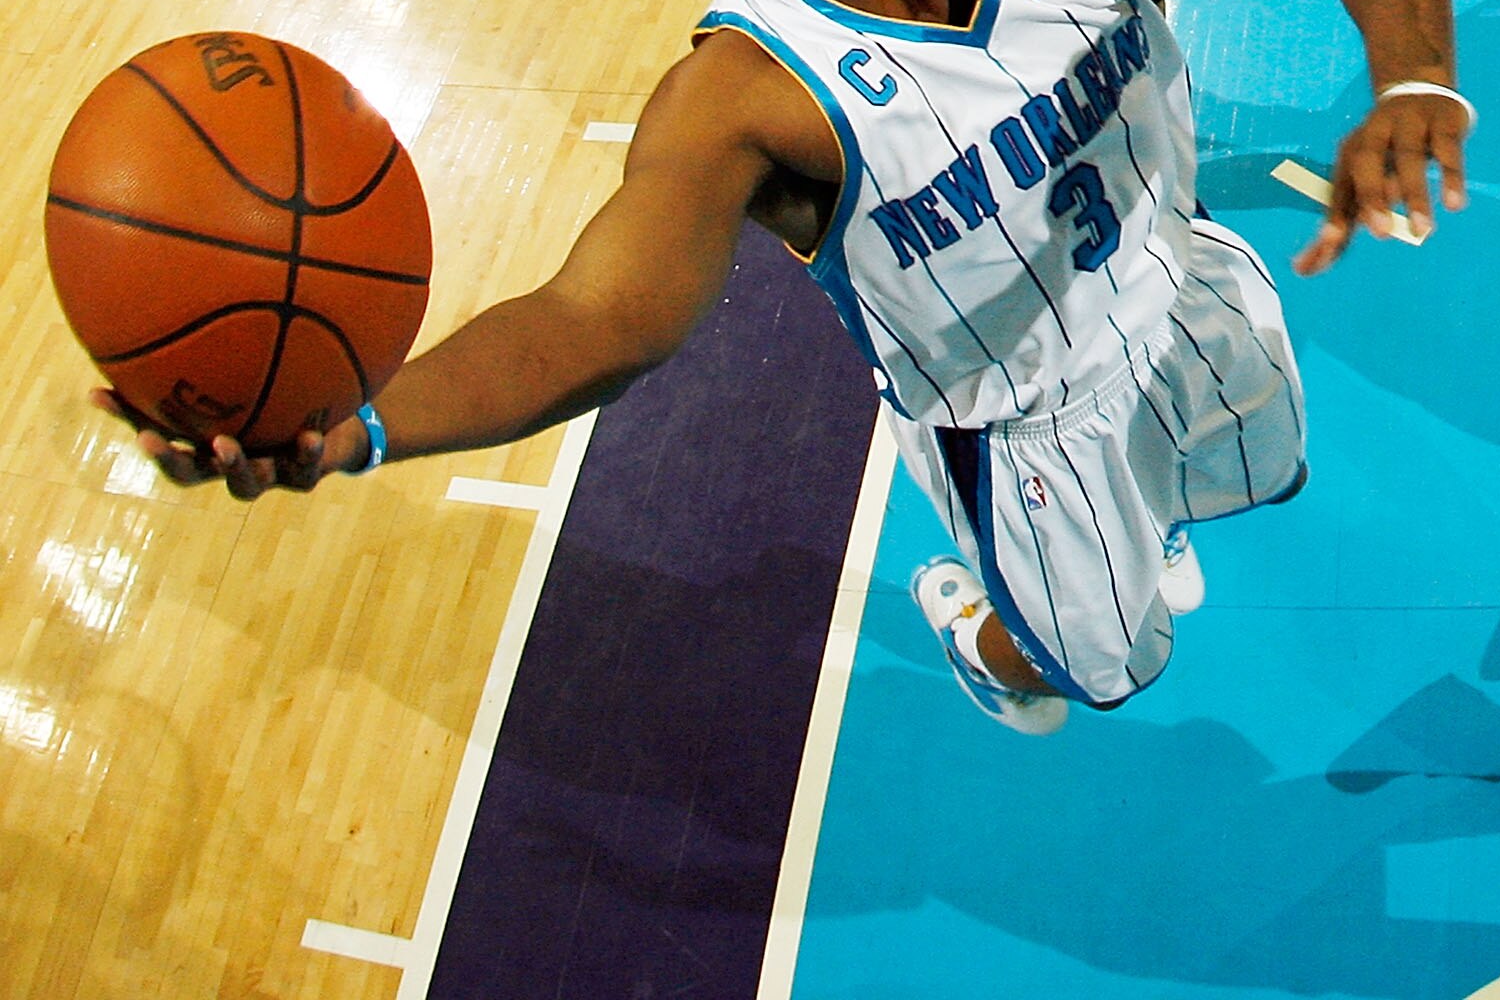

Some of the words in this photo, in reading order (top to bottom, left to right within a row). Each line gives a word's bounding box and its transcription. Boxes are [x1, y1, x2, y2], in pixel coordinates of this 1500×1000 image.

[837, 47, 898, 107] C
[868, 143, 1000, 271] NEW
[1048, 160, 1122, 273] 3
